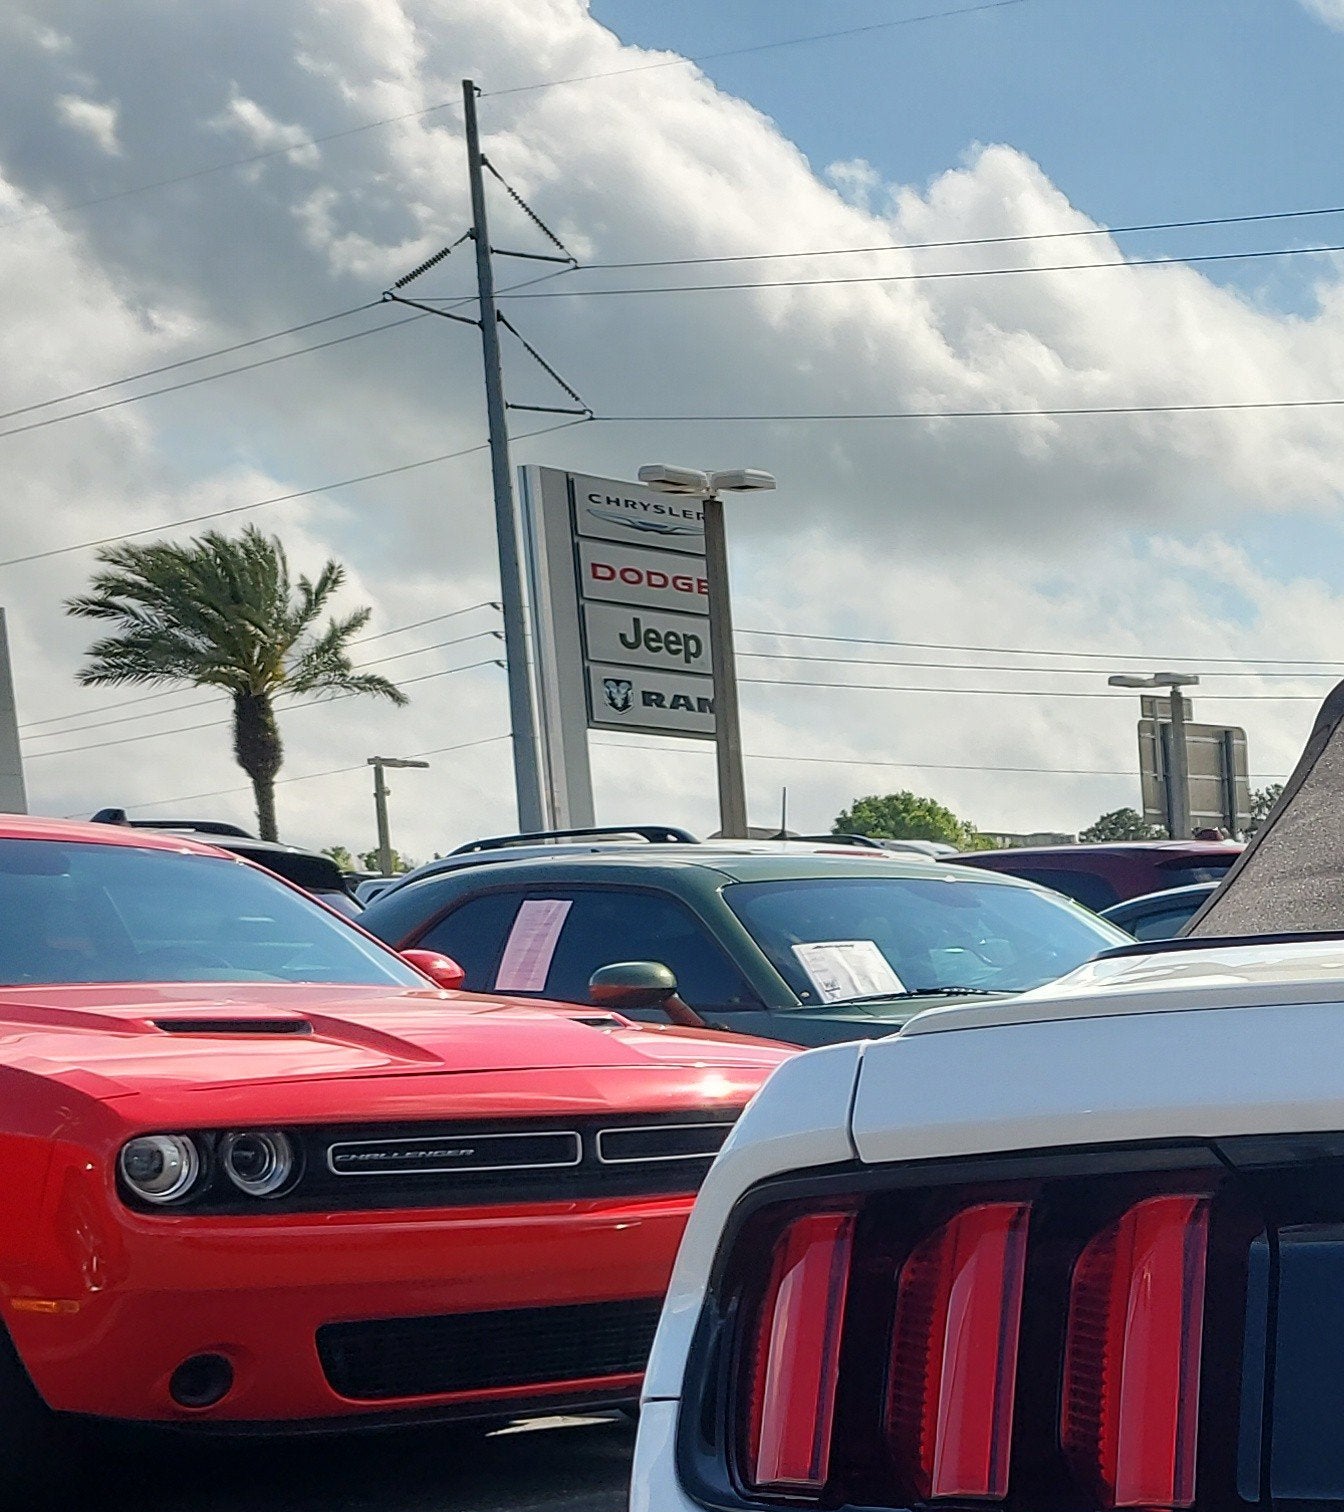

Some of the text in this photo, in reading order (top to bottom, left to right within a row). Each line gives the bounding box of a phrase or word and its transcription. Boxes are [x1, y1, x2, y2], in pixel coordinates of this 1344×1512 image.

[588, 493, 704, 520] CHRYSLER
[590, 562, 708, 595] DODGE
[619, 617, 702, 663] Jeep
[335, 1149, 475, 1161] CHALLENGER
